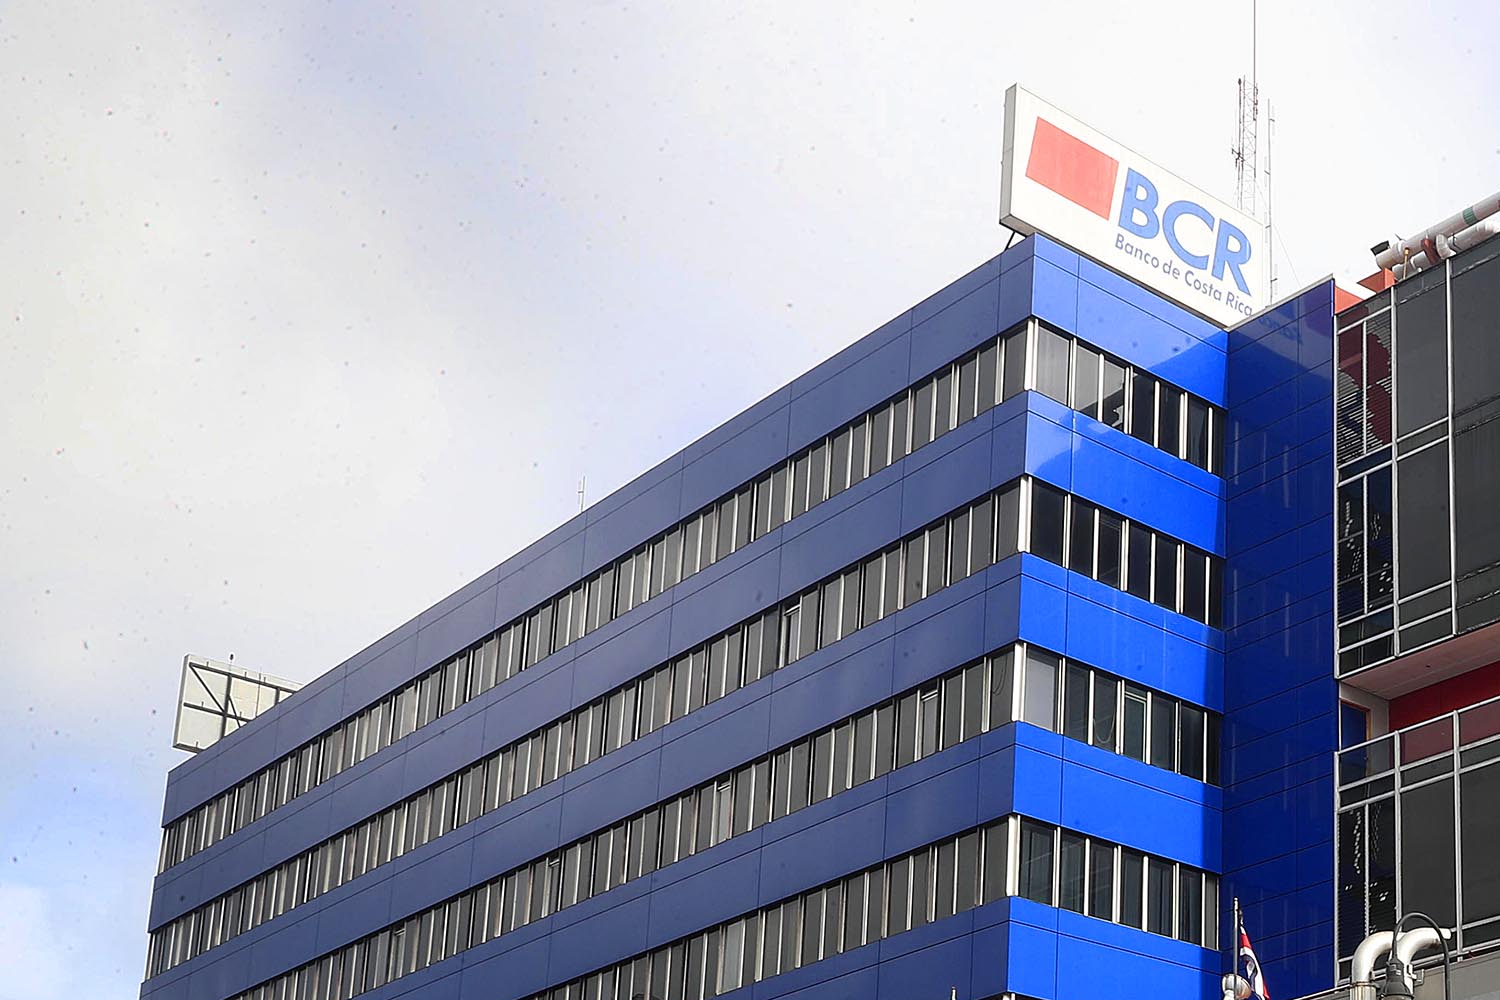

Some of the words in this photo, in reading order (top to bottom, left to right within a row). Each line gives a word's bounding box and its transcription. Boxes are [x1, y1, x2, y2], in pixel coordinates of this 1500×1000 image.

[1115, 233, 1160, 269] Banco
[1162, 260, 1180, 280] de
[1184, 270, 1222, 302] Costa
[1225, 292, 1253, 317] Rica
[1118, 167, 1252, 296] BCR
